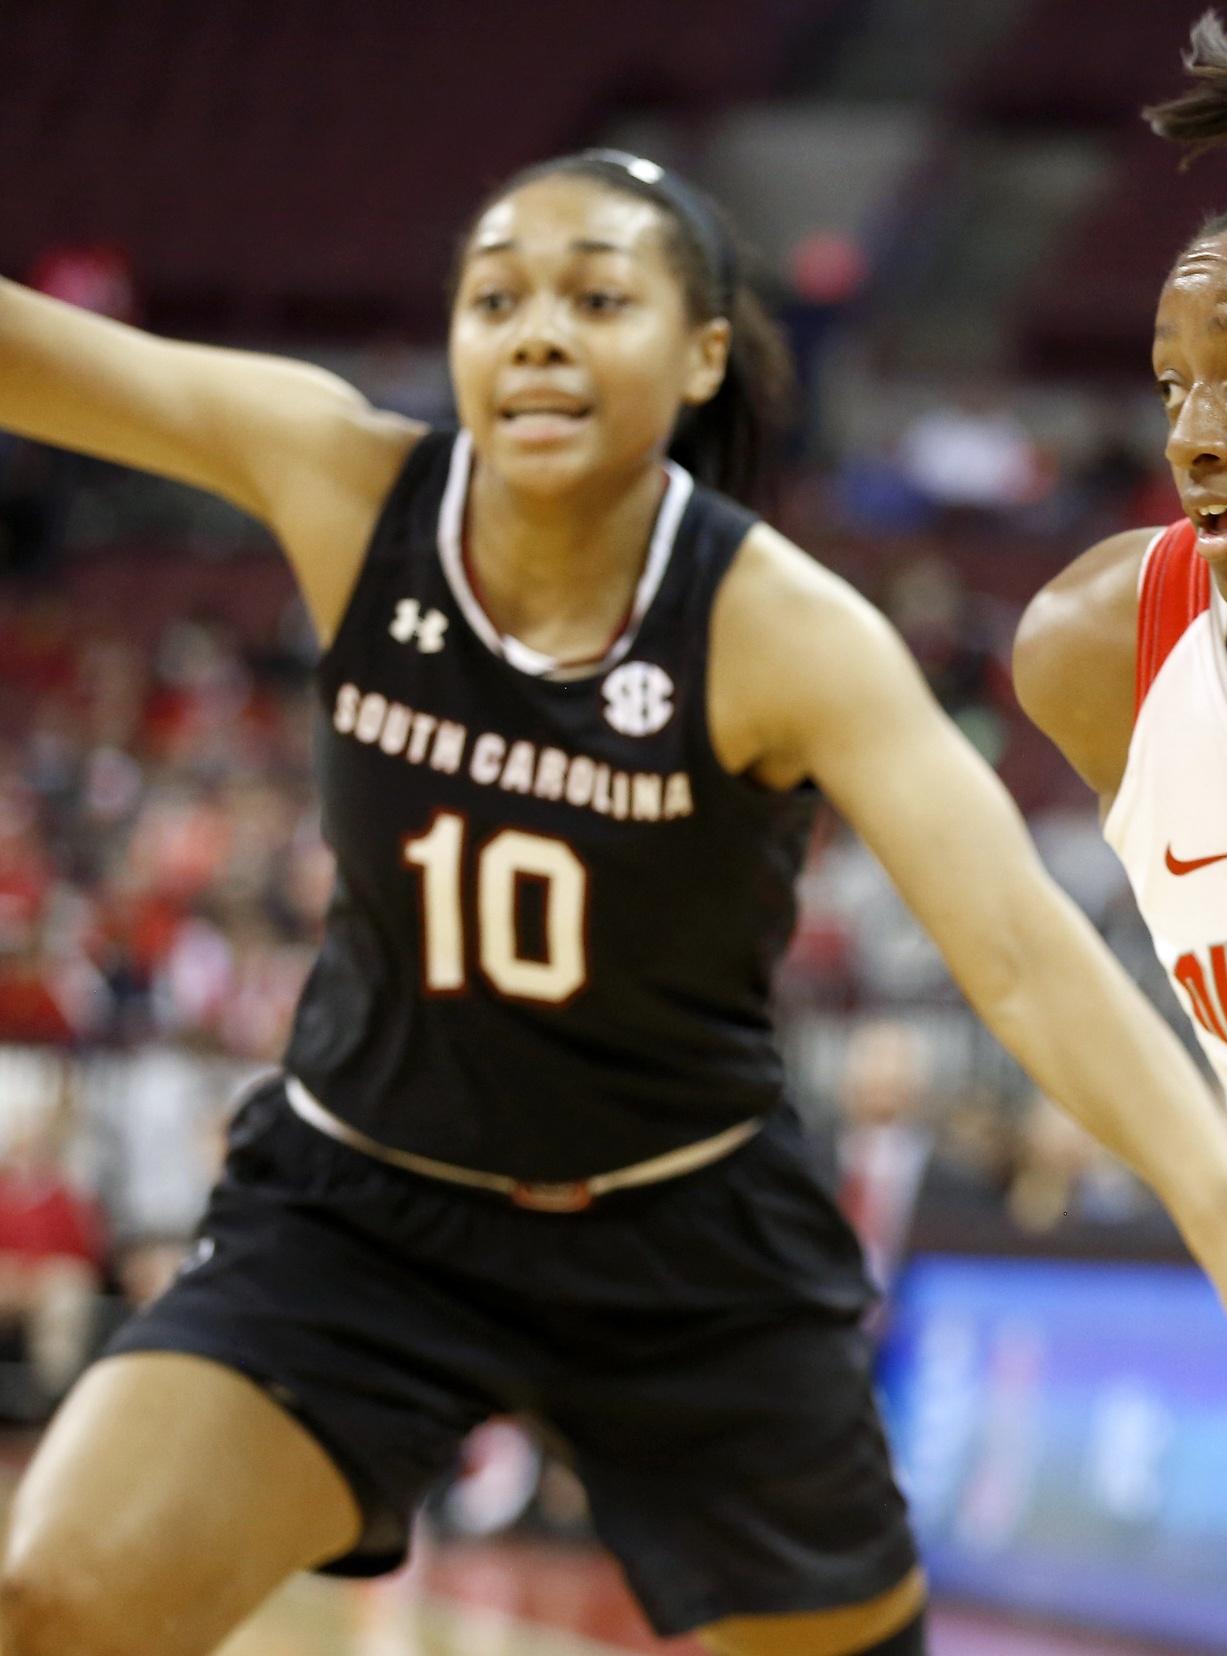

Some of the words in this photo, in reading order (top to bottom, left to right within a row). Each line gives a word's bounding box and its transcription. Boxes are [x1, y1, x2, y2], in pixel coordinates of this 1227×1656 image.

[333, 682, 466, 775] SOUTH
[469, 732, 694, 822] CAROLINA
[404, 809, 586, 1004] 10
